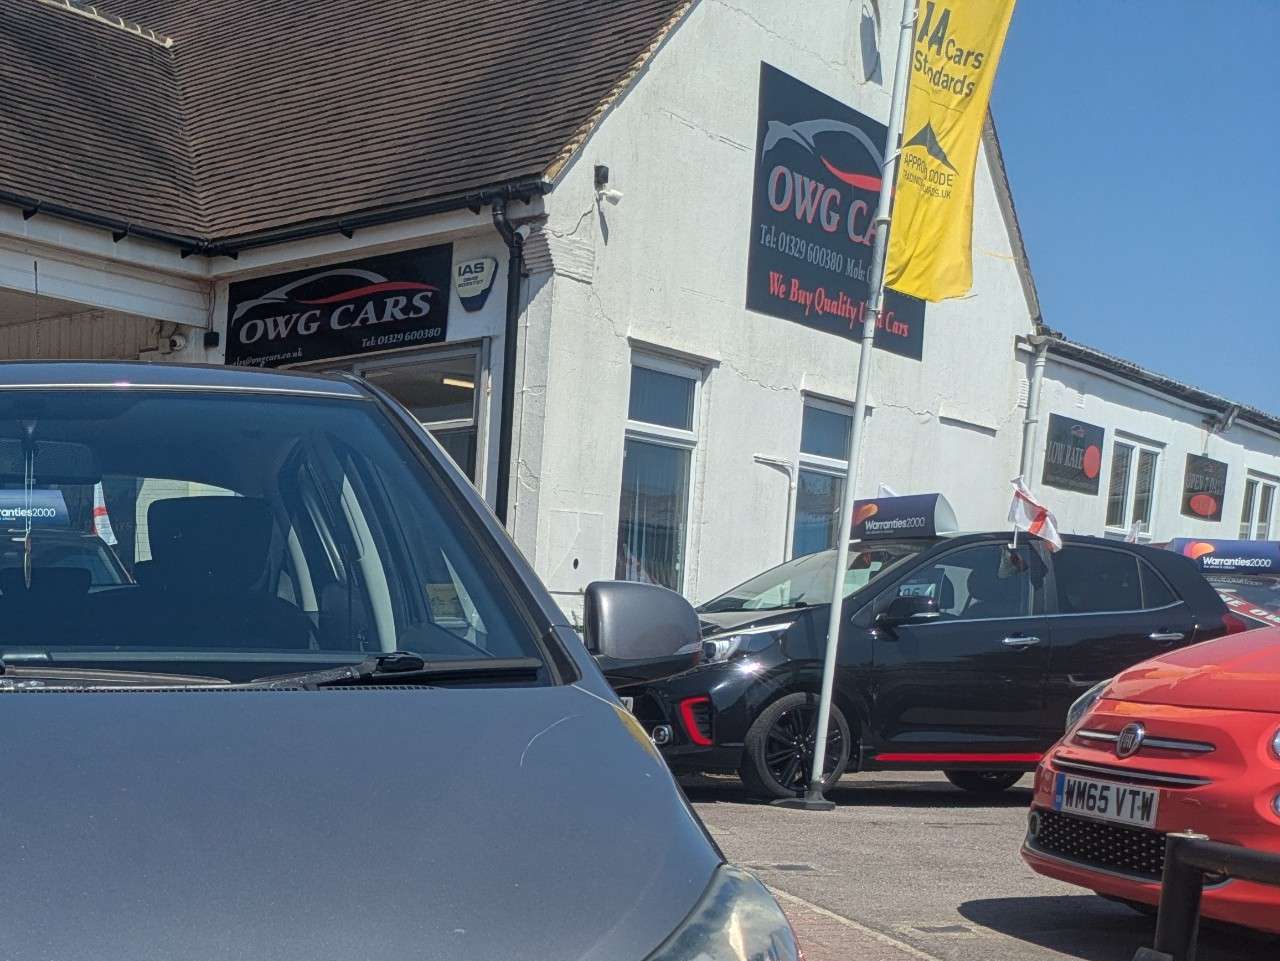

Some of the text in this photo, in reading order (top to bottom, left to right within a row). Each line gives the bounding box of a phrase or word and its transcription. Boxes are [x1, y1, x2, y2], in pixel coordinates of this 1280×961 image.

[914, 49, 976, 98] Stndards
[945, 38, 985, 70] Cars
[929, 168, 954, 188] CODE
[768, 165, 841, 232] OWG
[847, 200, 880, 247] CA
[458, 262, 484, 277] IAS
[760, 224, 776, 249] Tel:
[778, 231, 806, 260] 01329
[807, 243, 843, 273] 600380
[239, 291, 433, 344] OWG CARS
[769, 271, 787, 299] We
[789, 278, 813, 317] Buy
[815, 287, 857, 330] Quality
[886, 311, 909, 337] Cars
[865, 517, 926, 530] Warranties2000
[1202, 556, 1272, 568] Warranties2000
[1064, 778, 1155, 822] WM65 VTW
